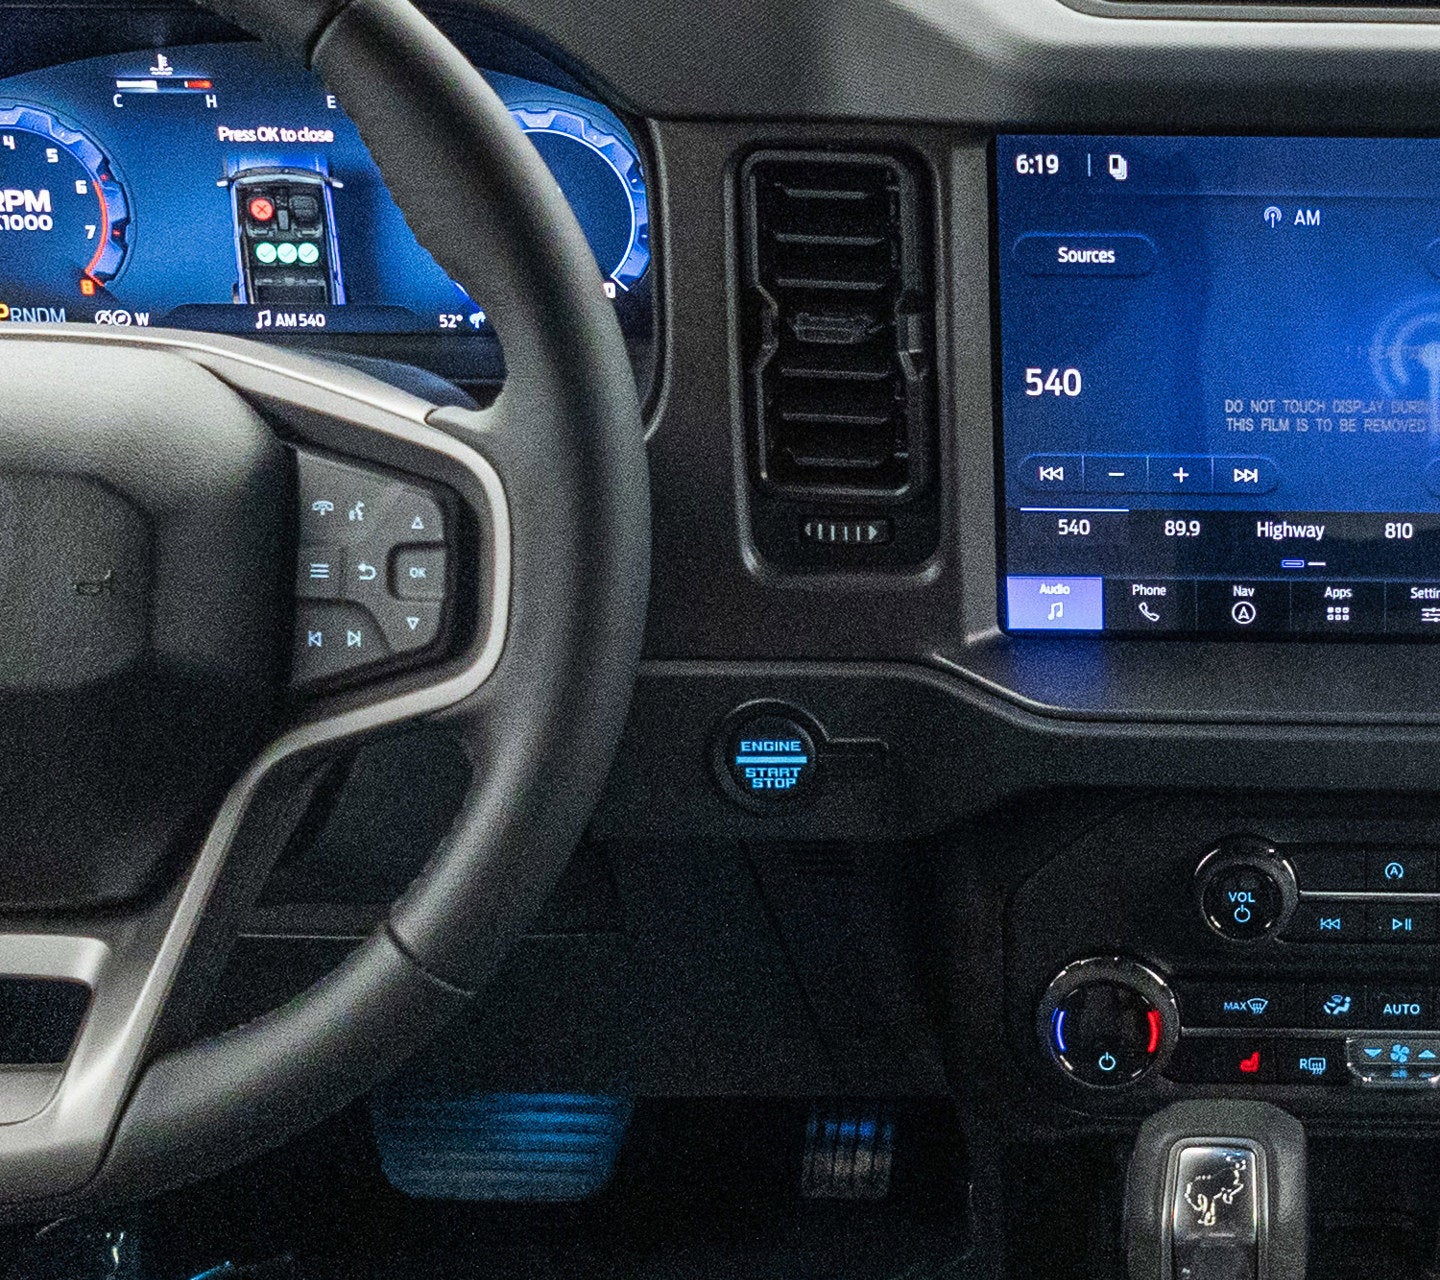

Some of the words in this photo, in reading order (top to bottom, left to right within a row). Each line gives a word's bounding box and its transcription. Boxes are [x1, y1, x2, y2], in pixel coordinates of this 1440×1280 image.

[113, 94, 124, 109] C
[205, 94, 219, 109] H
[326, 94, 337, 109] E
[217, 125, 257, 143] Press
[257, 125, 280, 143] OK
[281, 126, 298, 143] to
[297, 125, 335, 144] close
[2, 135, 16, 150] 4
[46, 148, 59, 163] 5
[1015, 154, 1060, 175] 6:19
[75, 180, 88, 194] 6
[1293, 209, 1321, 227] AM
[84, 225, 96, 239] 7
[1057, 245, 1116, 266] Sources
[80, 279, 95, 296] 8
[134, 312, 150, 326] W
[275, 313, 297, 327] AM
[298, 313, 326, 327] 540
[1024, 368, 1083, 397] 540
[1224, 399, 1244, 414] DO
[1250, 399, 1276, 414] NOT
[1283, 399, 1326, 414] TOUCH
[1332, 399, 1385, 414] DISPLAY
[1226, 418, 1255, 433] THIS
[1260, 418, 1290, 433] FILM
[1296, 418, 1309, 433] IS
[1316, 418, 1333, 433] TO
[1339, 418, 1357, 433] BE
[1364, 418, 1426, 433] REMOVED
[1057, 519, 1091, 537] 540
[1164, 519, 1201, 538] 89.9
[1256, 519, 1326, 542] Highway
[1384, 521, 1414, 540] 810
[409, 567, 427, 579] OK
[1039, 582, 1071, 596] Audio
[1132, 583, 1168, 598] Phone
[1232, 584, 1256, 598] Nav
[1323, 585, 1353, 602] Apps
[740, 740, 802, 752] ENGINE
[745, 767, 802, 778] START
[752, 778, 797, 789] STOP
[1228, 890, 1256, 904] VOL
[1223, 1000, 1248, 1012] MAX
[1382, 1002, 1421, 1016] AUTO
[1299, 1058, 1309, 1071] R
